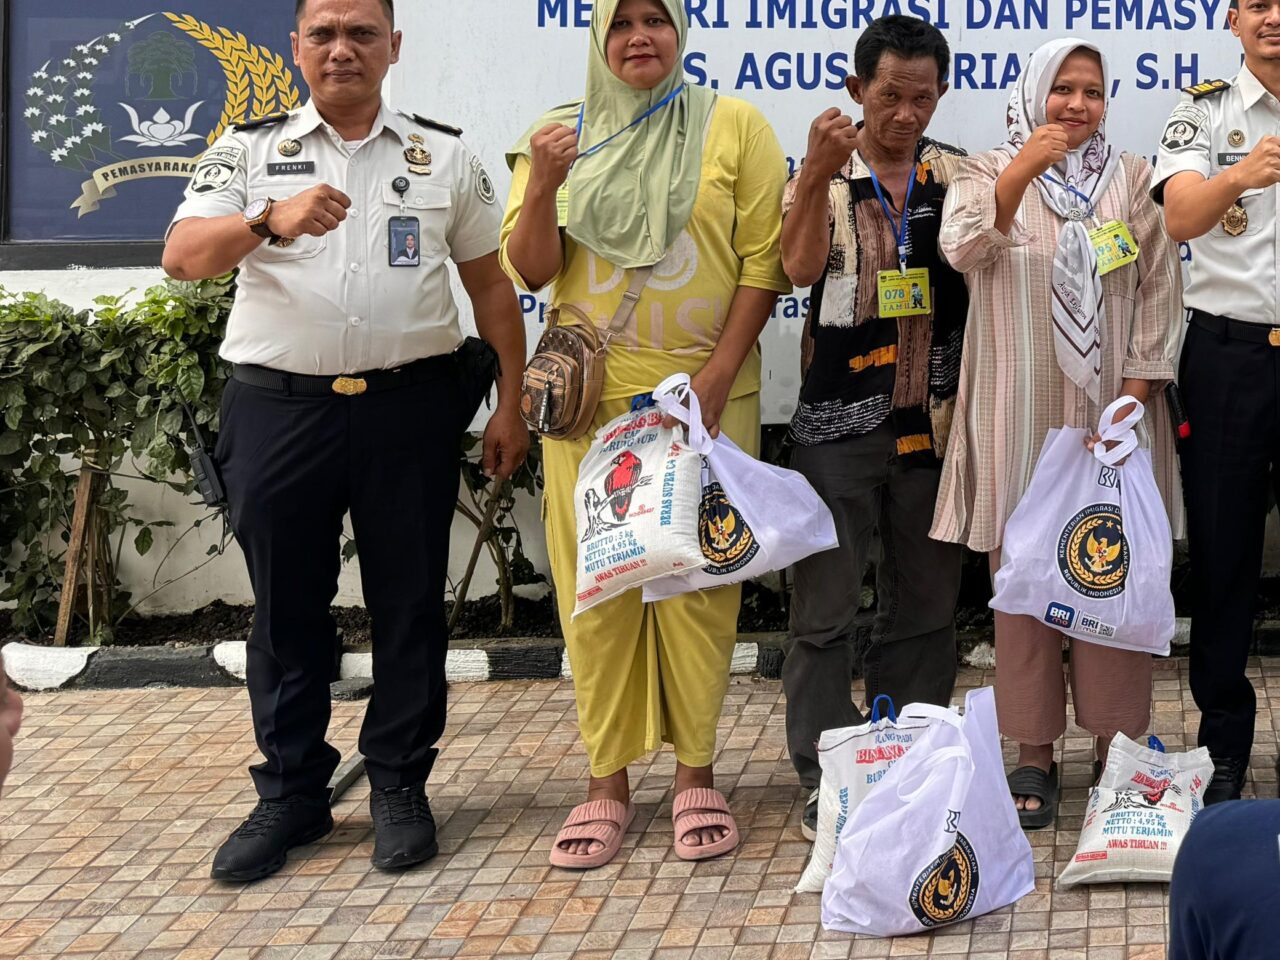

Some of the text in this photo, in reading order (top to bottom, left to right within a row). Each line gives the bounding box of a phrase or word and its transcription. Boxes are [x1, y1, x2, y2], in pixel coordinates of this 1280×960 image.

[735, 52, 849, 90] AGUS
[663, 470, 676, 498] SUPER
[660, 499, 673, 526] BERAS
[1059, 505, 1114, 559] KEMENTERIAN IMIGRASI
[586, 535, 614, 552] BRUTTO
[584, 548, 607, 563] NETTO
[584, 544, 647, 574] MUTU TERJAMIN
[594, 569, 614, 583] AWAS
[613, 561, 641, 577] TIRUAN
[1063, 568, 1123, 598] REPUBLIK INDONESIA
[1050, 606, 1071, 621] BRI
[1081, 617, 1099, 629] BRI
[1105, 818, 1132, 826] NETTO
[1110, 810, 1142, 819] BRUTTO
[1102, 826, 1173, 837] MUTU TERJAMIN
[1106, 839, 1129, 849] AWAS
[1129, 838, 1159, 850] TIRUAN
